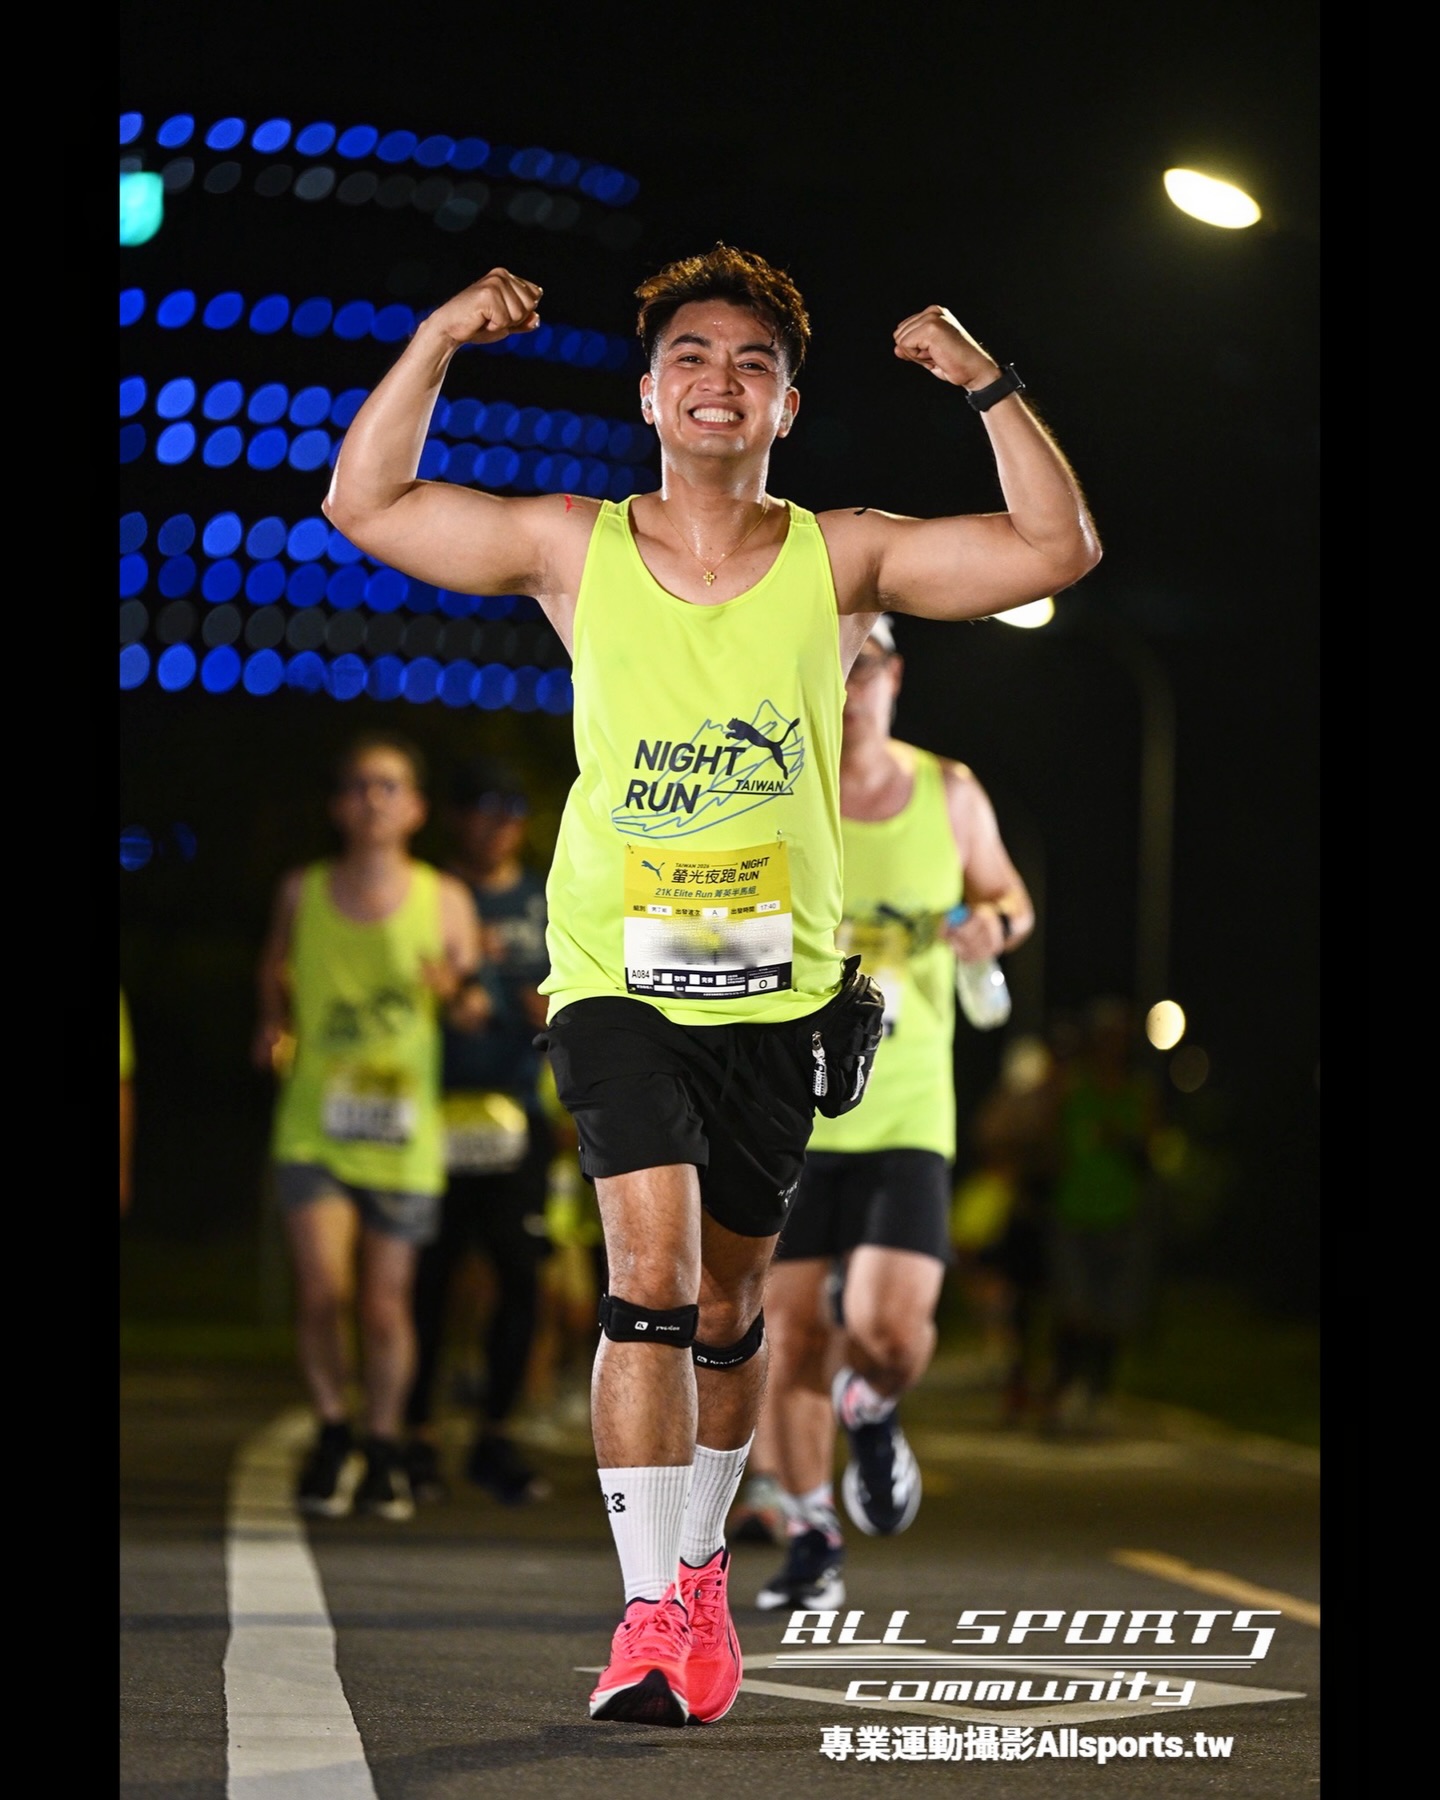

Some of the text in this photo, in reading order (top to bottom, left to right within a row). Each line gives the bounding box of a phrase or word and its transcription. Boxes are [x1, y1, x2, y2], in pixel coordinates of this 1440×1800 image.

[634, 739, 746, 776] NIGHT
[735, 779, 784, 793] TAIWAN
[625, 779, 701, 814] RUN
[740, 856, 770, 870] NIGHT
[671, 868, 737, 884] 螢光夜跑
[738, 871, 760, 882] RUN
[655, 887, 672, 896] 21K
[673, 888, 693, 898] Elite
[695, 889, 713, 898] Run
[631, 969, 651, 979] A084
